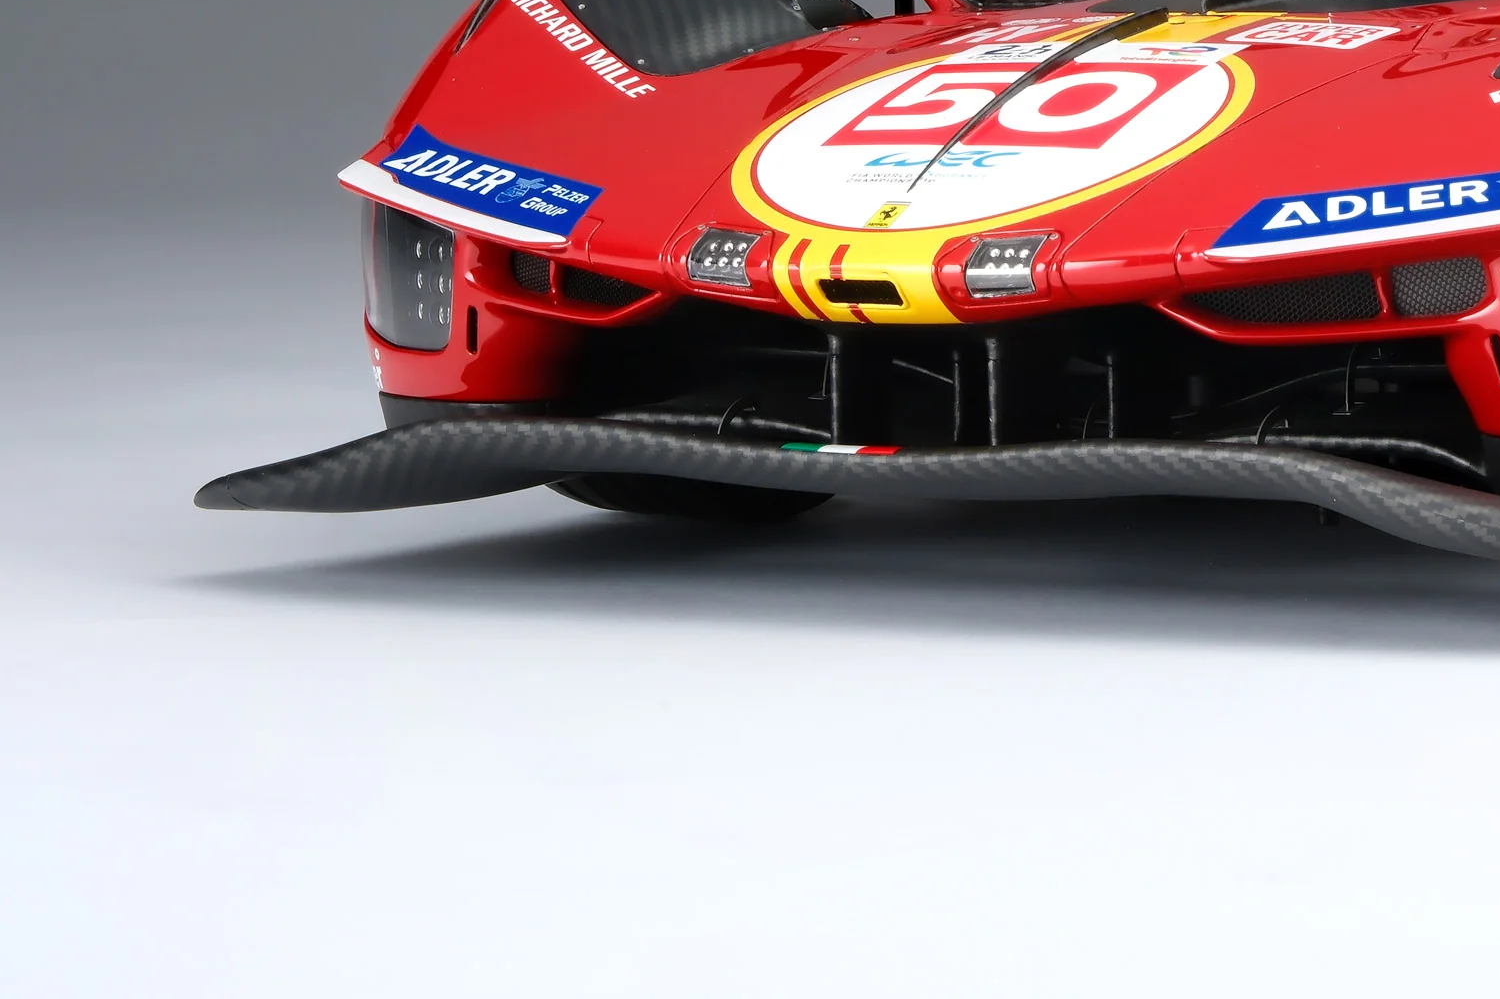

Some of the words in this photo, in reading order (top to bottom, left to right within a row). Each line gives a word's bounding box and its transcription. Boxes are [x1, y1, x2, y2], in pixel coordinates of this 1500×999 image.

[1244, 29, 1365, 46] CAR
[1267, 23, 1385, 36] HYPER
[580, 48, 657, 98] MILLE
[852, 70, 1158, 133] 50
[383, 149, 517, 196] ADLER
[520, 197, 568, 217] GROUP
[543, 184, 590, 205] PELZER
[1262, 180, 1490, 232] ADLER
